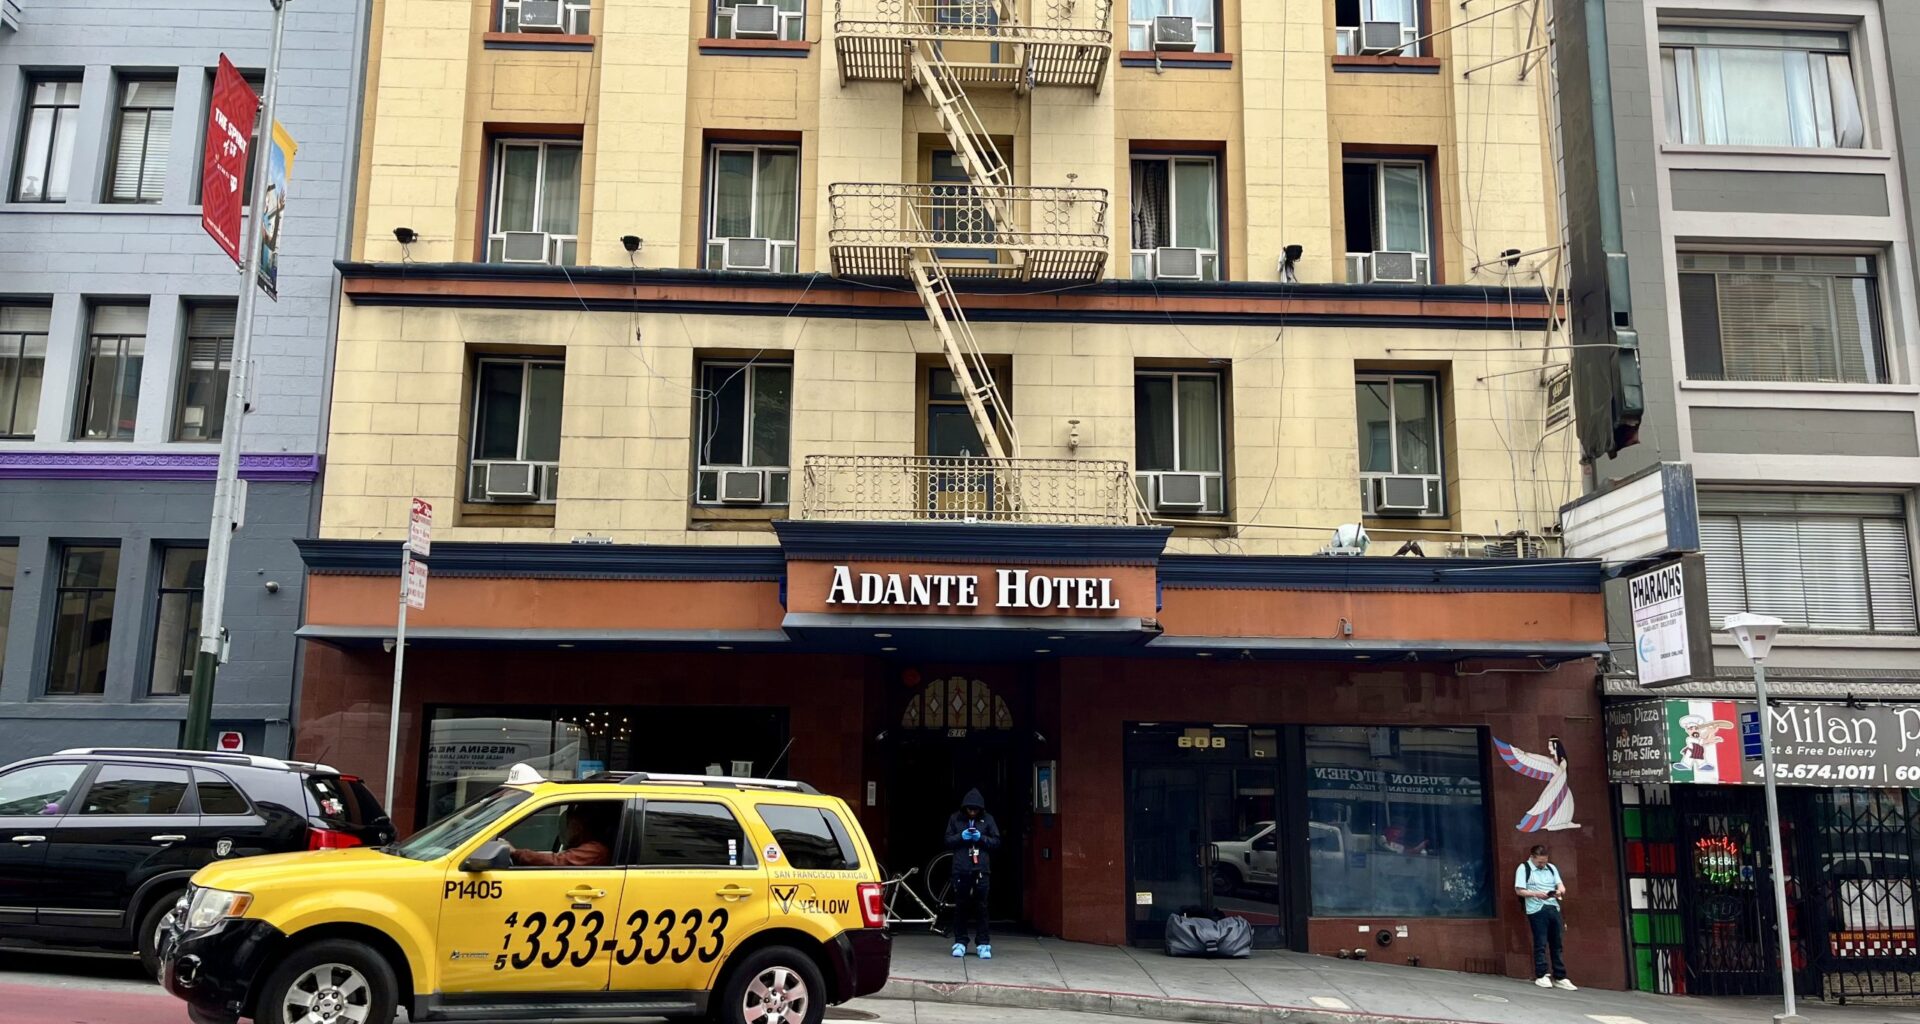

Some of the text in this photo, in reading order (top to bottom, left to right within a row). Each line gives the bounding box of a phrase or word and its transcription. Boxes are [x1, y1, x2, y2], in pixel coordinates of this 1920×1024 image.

[215, 107, 247, 154] THE SPIRIT
[1632, 565, 1682, 609] PHARAOHS
[1609, 707, 1659, 726] Milan Pizza
[1768, 706, 1877, 744] Milan
[1178, 736, 1226, 748] 608
[1616, 735, 1653, 747] Hot Pizza
[1612, 747, 1660, 763] By The Slice
[1785, 746, 1793, 754] &
[1797, 746, 1824, 755] Free
[1828, 747, 1876, 757] Delivery
[1630, 768, 1641, 776] Free
[774, 870, 868, 880] SAN FRANCISCO TAXICAB
[444, 880, 503, 900] P1405
[799, 899, 850, 914] YELLOW
[511, 907, 729, 970] 333-3333
